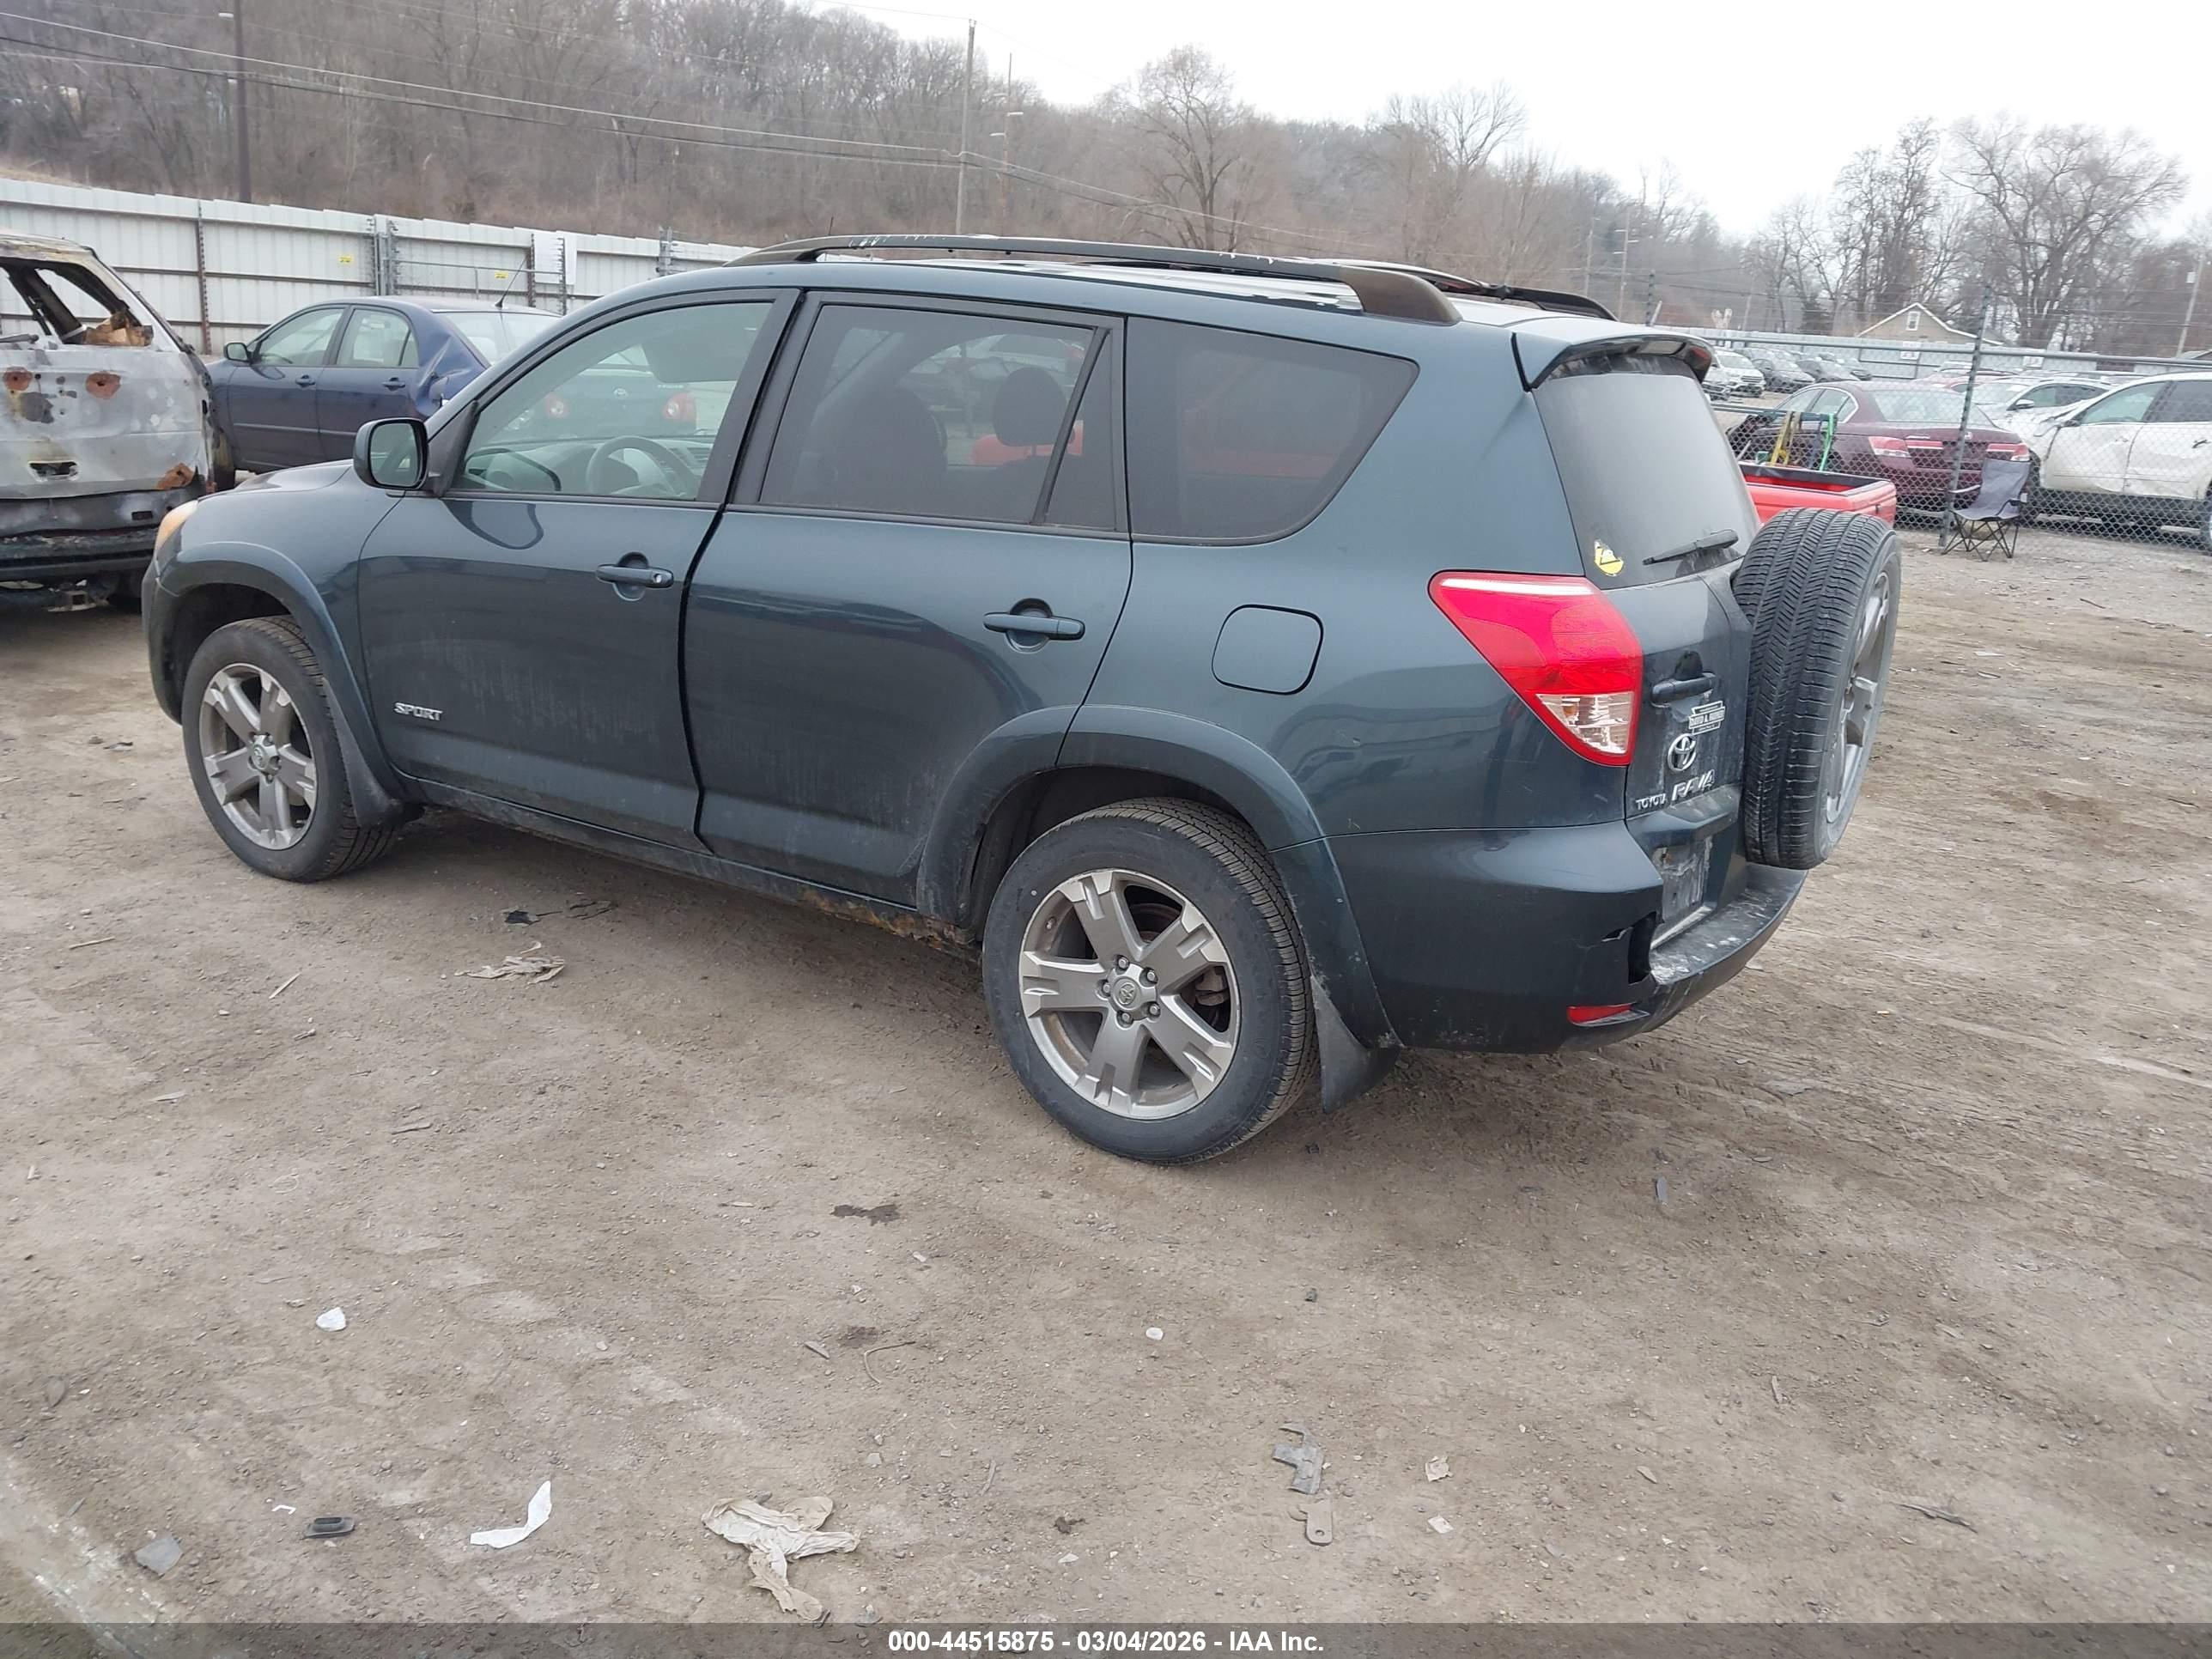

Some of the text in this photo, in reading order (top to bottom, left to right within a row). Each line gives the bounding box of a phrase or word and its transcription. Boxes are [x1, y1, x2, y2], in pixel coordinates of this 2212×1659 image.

[394, 702, 443, 721] SPORT
[1635, 769, 1716, 811] TOYOTA RAV4
